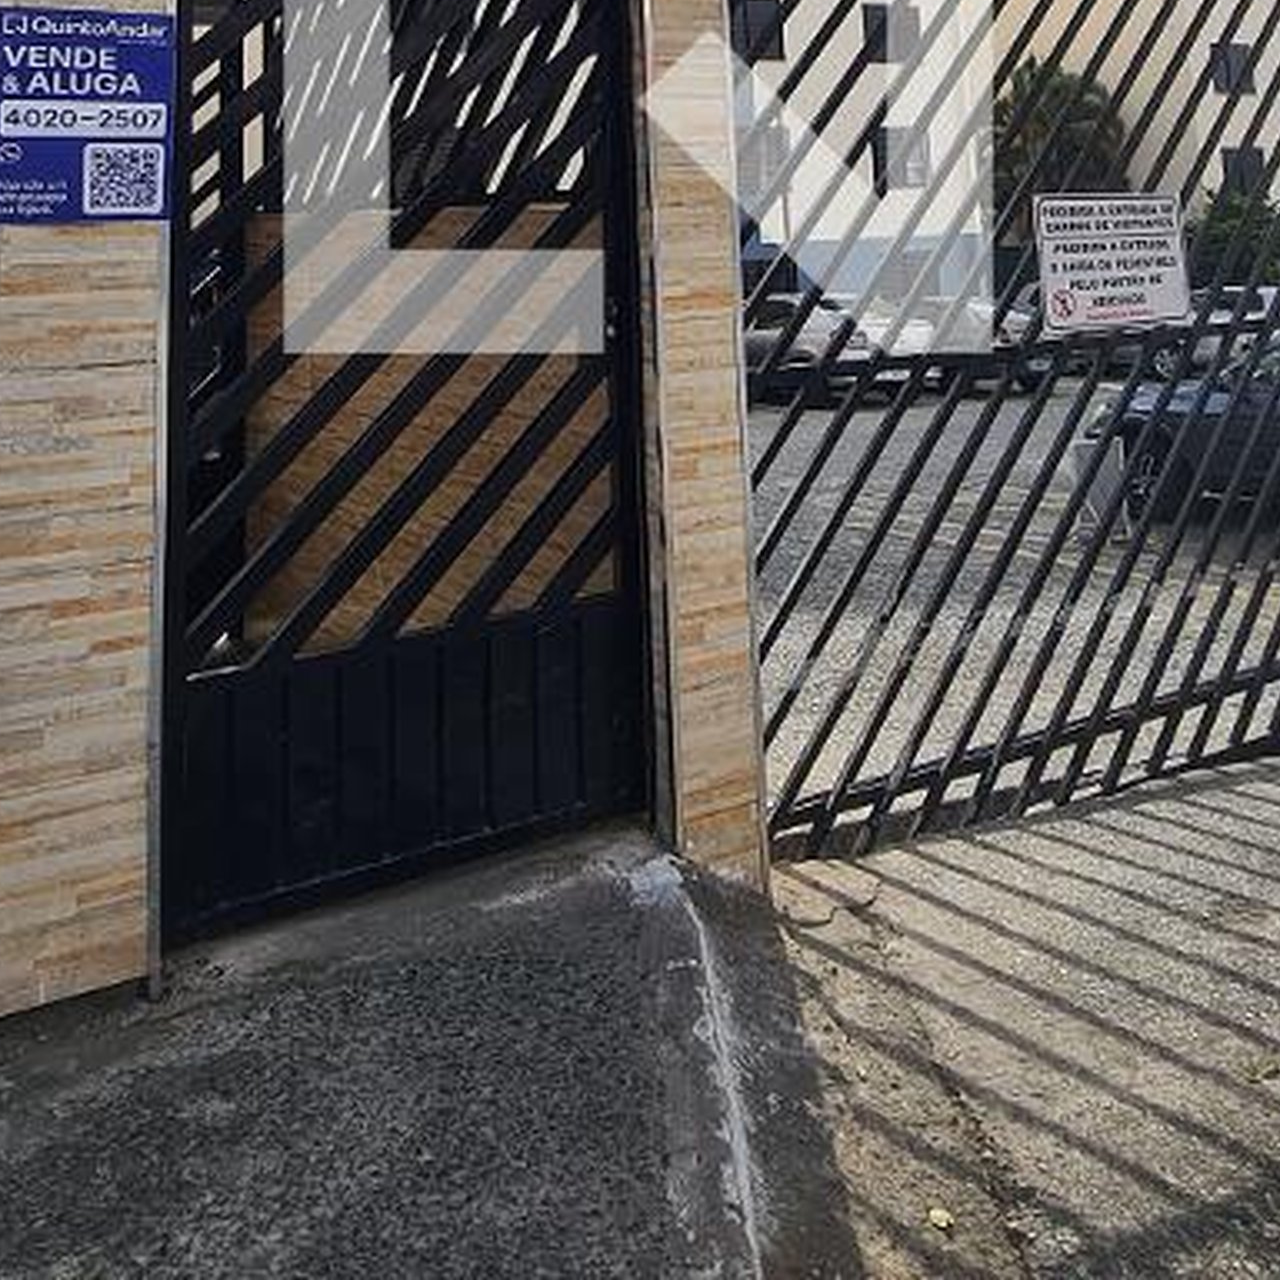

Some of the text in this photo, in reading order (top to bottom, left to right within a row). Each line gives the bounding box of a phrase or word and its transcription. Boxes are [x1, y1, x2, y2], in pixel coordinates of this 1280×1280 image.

[32, 16, 168, 38] QuintoAndar
[3, 46, 117, 70] VENDE
[2, 71, 141, 95] & ALUGA
[4, 108, 163, 129] 4020-2507
